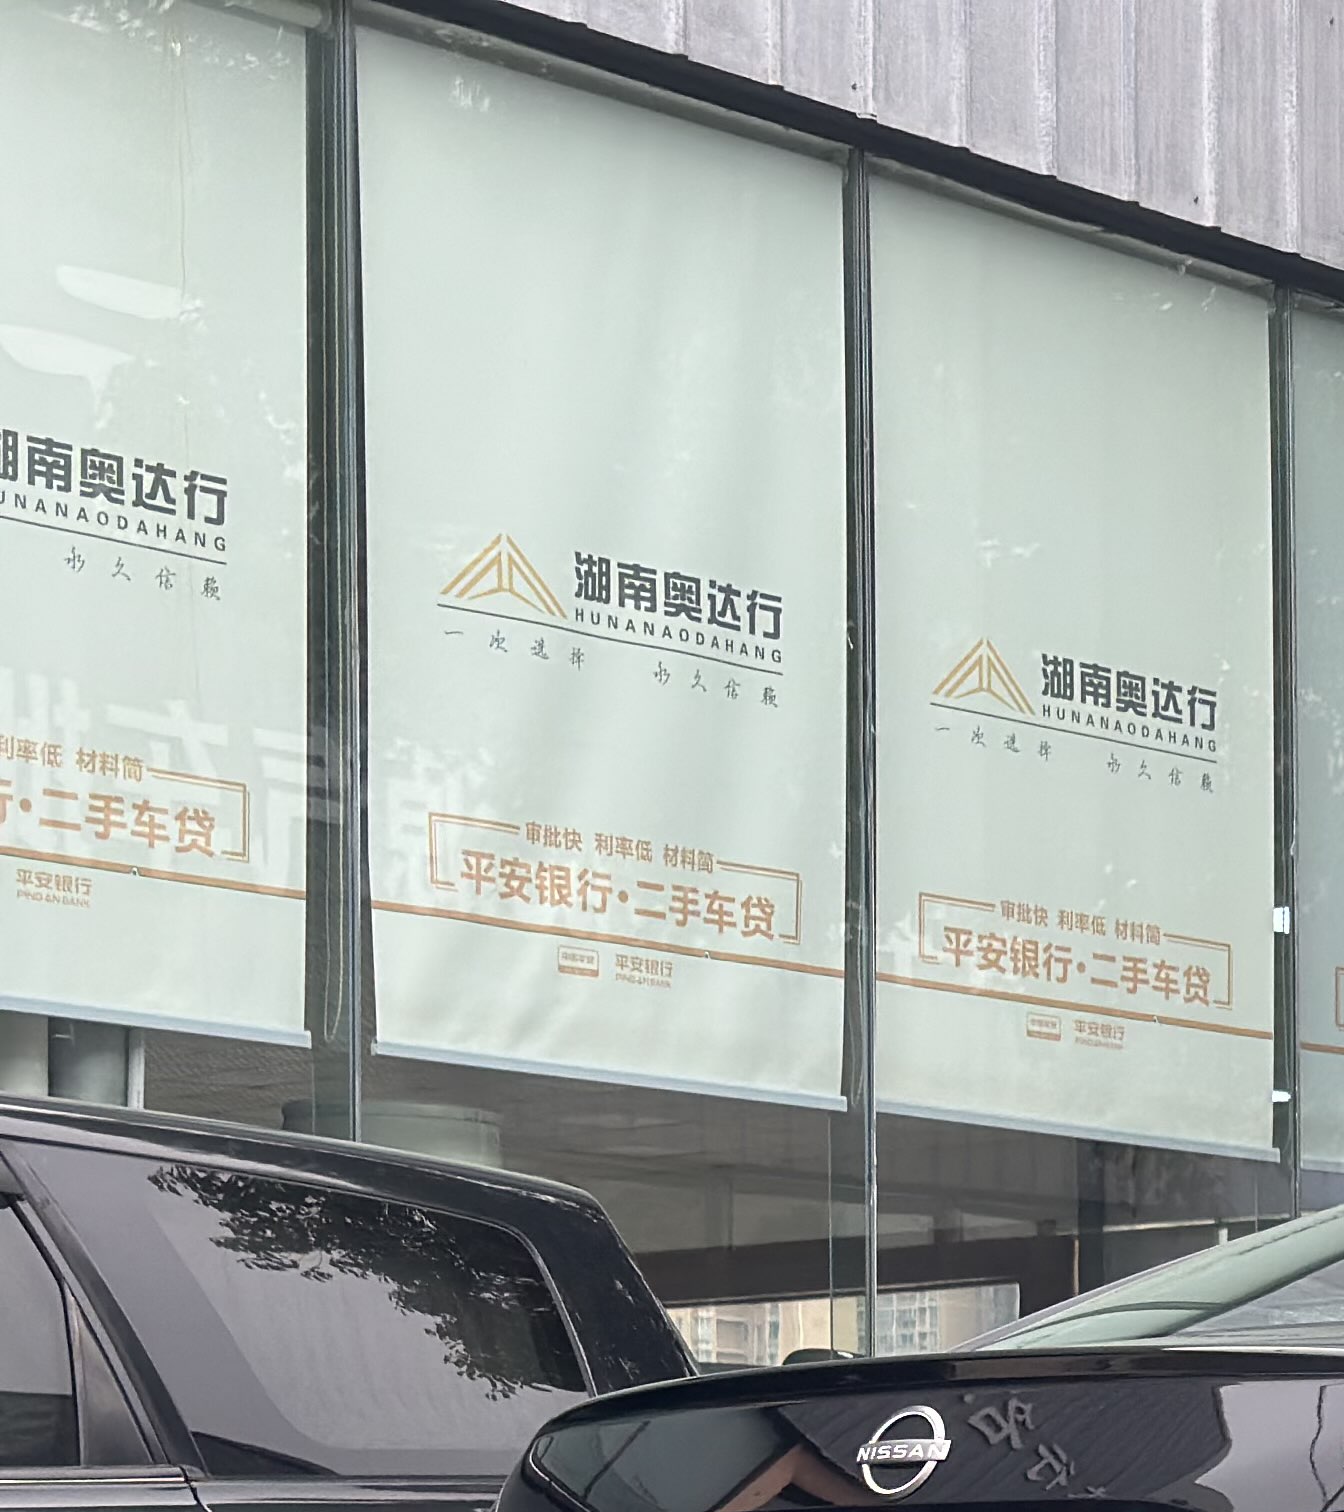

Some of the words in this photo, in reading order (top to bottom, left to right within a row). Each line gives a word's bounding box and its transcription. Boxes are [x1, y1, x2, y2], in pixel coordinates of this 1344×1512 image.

[574, 551, 783, 640] 湖南奥达行
[443, 629, 586, 671] 一次选择
[574, 608, 783, 664] HUNANAODAHANG
[1041, 654, 1218, 732] 湖南奥达行
[1042, 704, 1217, 753] HUNANAODAHANG
[76, 747, 144, 782] 材料简
[525, 821, 583, 852] 审批快
[594, 832, 653, 863] 利率低
[663, 843, 714, 874] 材料简
[16, 868, 92, 896] 平安银行
[460, 848, 776, 941] 平安银行·二手车贷
[942, 925, 1212, 1007] 平安银行·二手车贷
[856, 1442, 951, 1463] NISSAN
